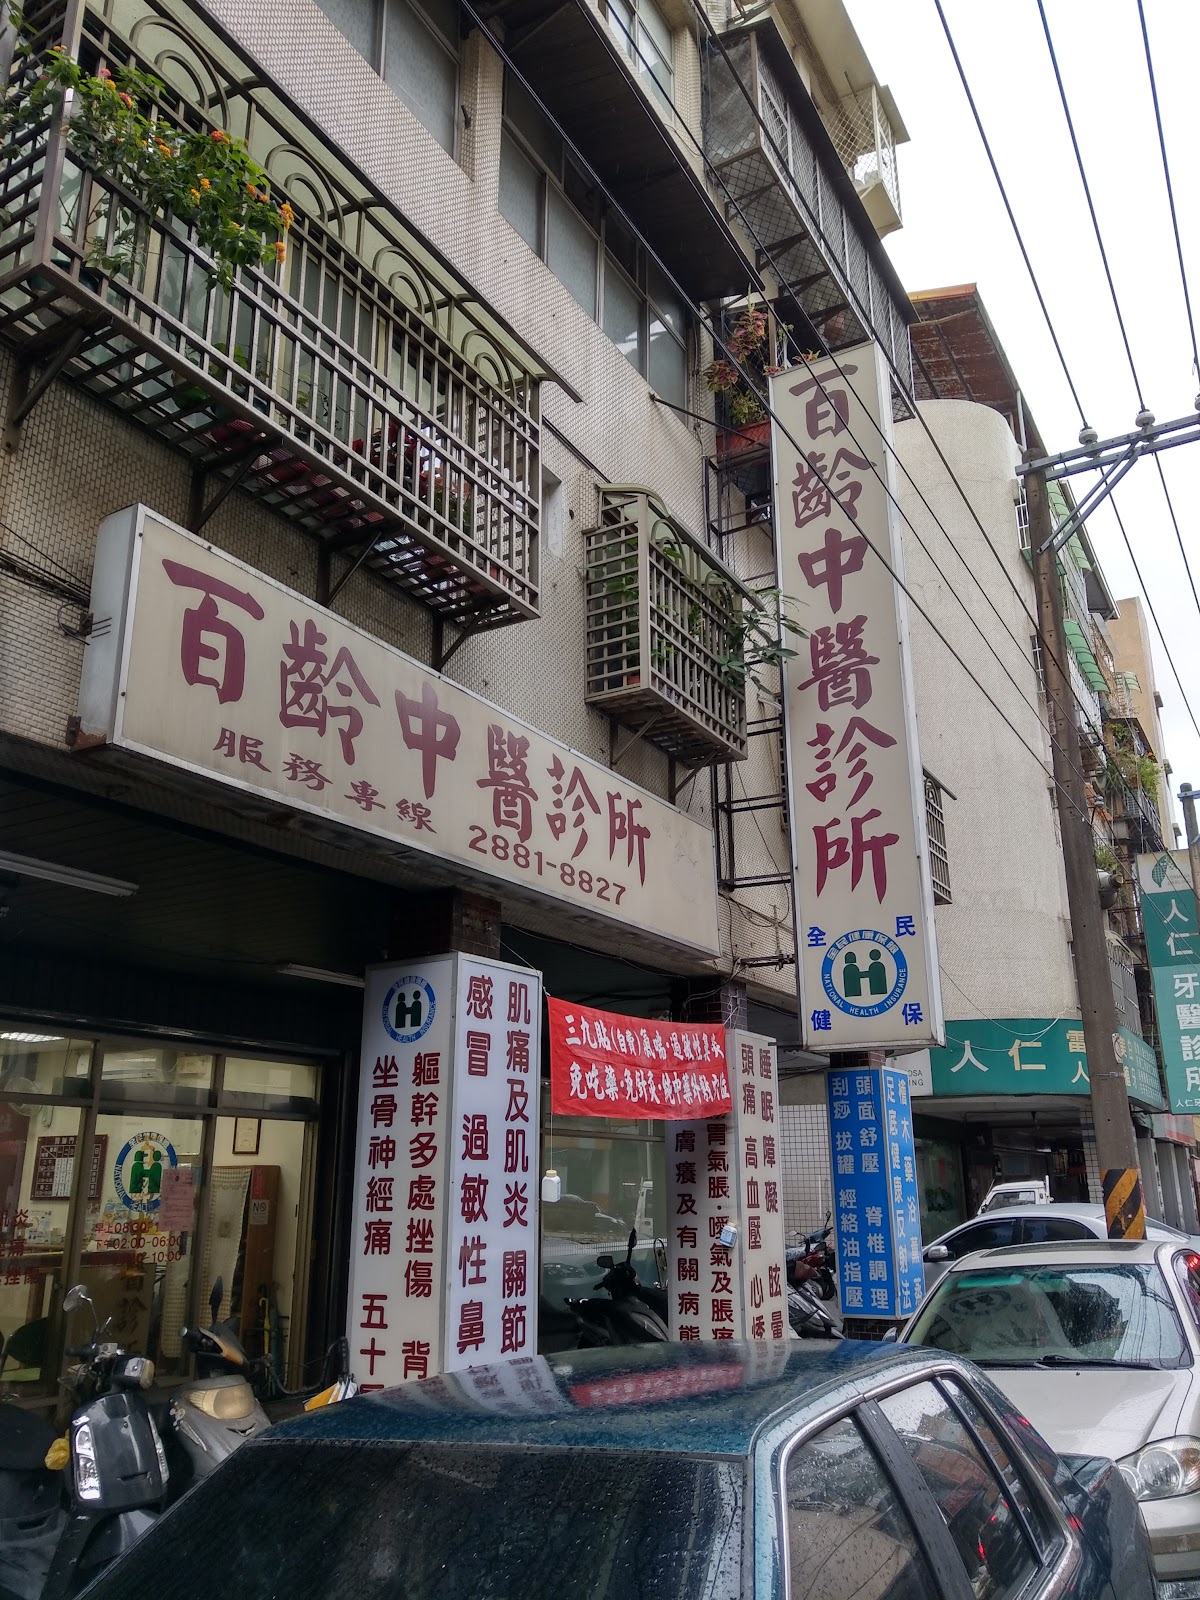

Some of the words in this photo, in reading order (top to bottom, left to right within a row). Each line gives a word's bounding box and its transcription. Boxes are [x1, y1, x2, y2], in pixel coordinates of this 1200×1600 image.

[789, 363, 899, 904] 百齡中醫診所
[162, 559, 651, 886] 百齡中醫診所
[213, 727, 437, 833] 服務專線
[468, 825, 626, 905] 2881-8827
[465, 974, 493, 1077] 感冒
[824, 973, 844, 1008] NATIONAL
[849, 1006, 879, 1016] HEALTH
[884, 968, 906, 1008] INSURANCE
[503, 980, 532, 1228] 肌痛及肌炎
[741, 1043, 755, 1115] 頭痛
[759, 1048, 778, 1213] 睡眠障礙
[832, 1076, 851, 1120] 刮痧
[856, 1076, 879, 1173] 頭面舒壓
[364, 1055, 399, 1256] 坐骨神經痛
[404, 1052, 441, 1299] 軀幹多處挫傷
[745, 1136, 761, 1250] 高血壓
[835, 1131, 855, 1175] 拔罐
[457, 1114, 489, 1367] 過敏性鼻
[675, 1118, 700, 1340] 膚癢及有關病態
[839, 1188, 864, 1308] 經絡油指壓
[865, 1206, 889, 1310] 脊椎調理
[402, 1340, 430, 1379] 背
[500, 1250, 528, 1354] 關節
